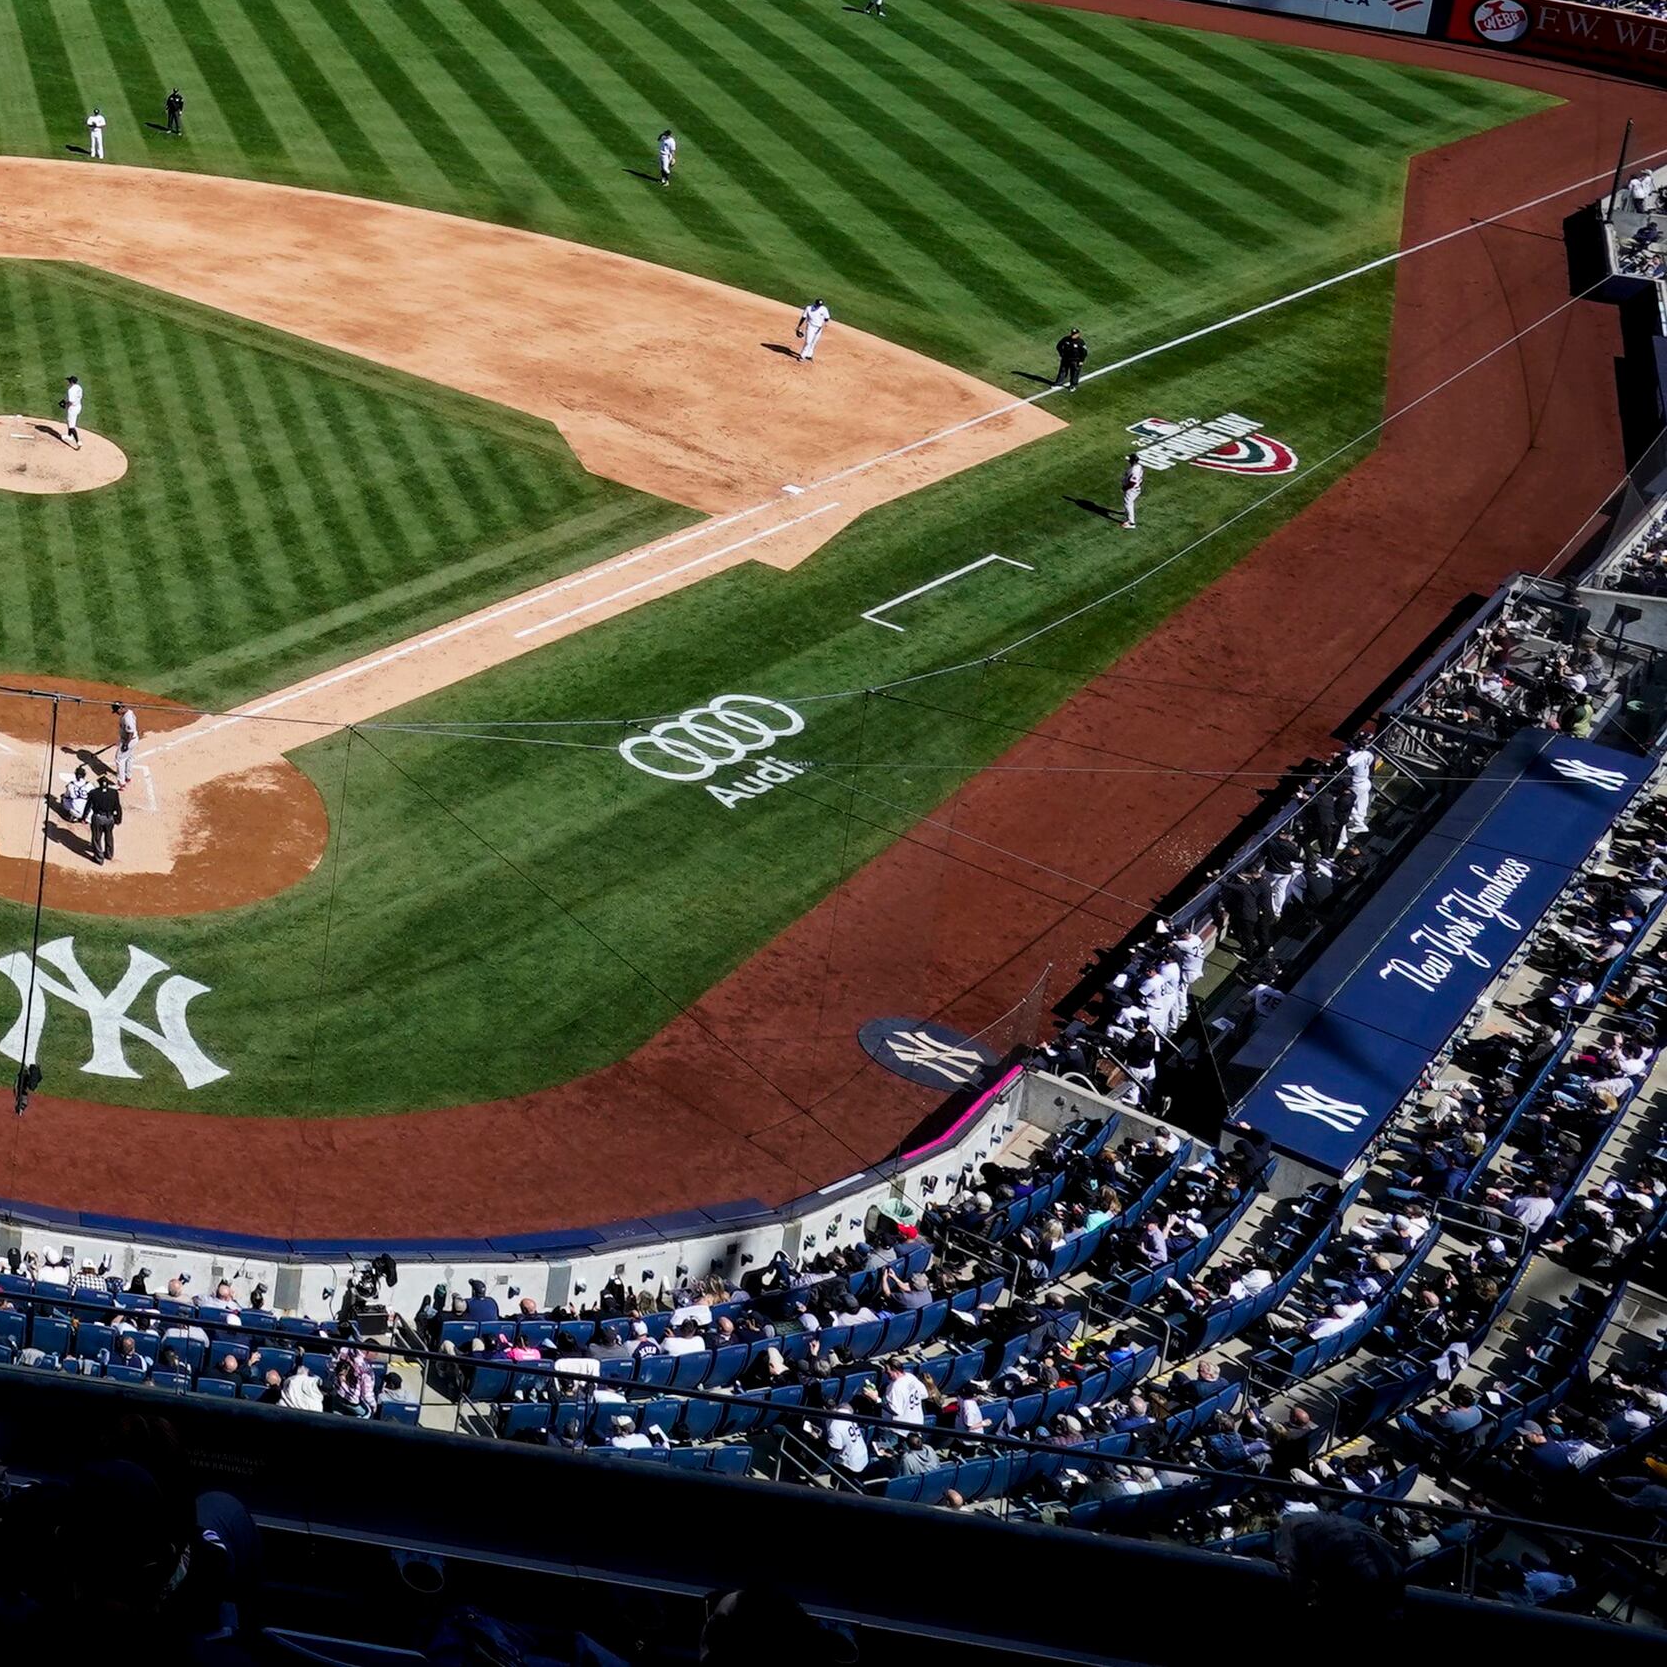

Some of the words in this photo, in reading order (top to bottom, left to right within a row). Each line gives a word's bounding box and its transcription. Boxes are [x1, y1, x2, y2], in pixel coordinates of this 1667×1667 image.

[1482, 9, 1520, 31] WEBB
[705, 755, 805, 810] Audi
[1549, 758, 1631, 792] NY
[1442, 857, 1531, 931] Yankees
[1410, 904, 1492, 969] York
[1379, 949, 1453, 993] New
[885, 1028, 987, 1086] NY
[1274, 1083, 1371, 1133] NY
